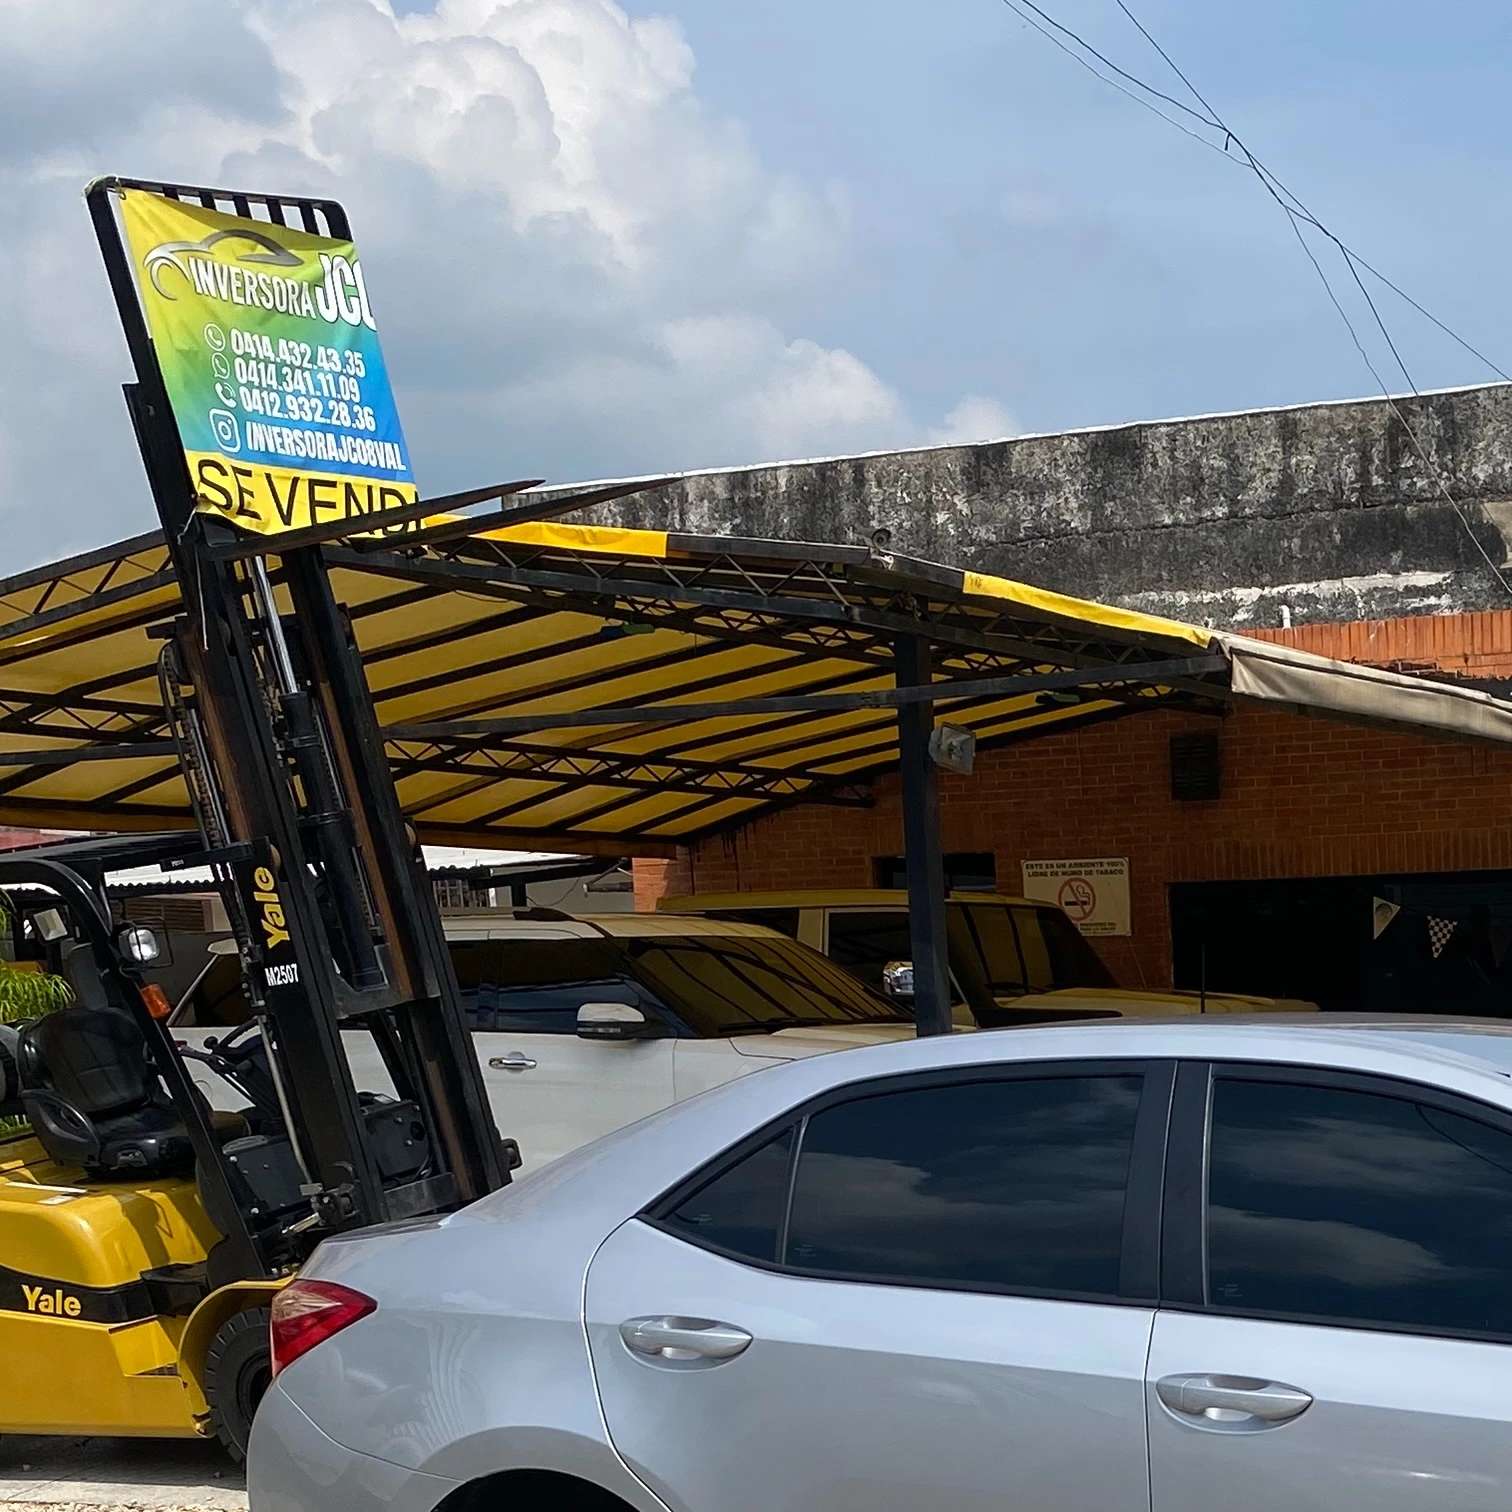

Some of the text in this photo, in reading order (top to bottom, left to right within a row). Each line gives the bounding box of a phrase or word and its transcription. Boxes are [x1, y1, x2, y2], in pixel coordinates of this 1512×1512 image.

[188, 257, 317, 320] INVERSORA
[230, 328, 367, 379] 0414.432.43.35
[234, 357, 362, 403] 0414.341.11.09
[238, 385, 376, 432] 0412.932.28.36
[198, 459, 263, 520] SE
[1068, 861, 1104, 869] AMBIENTE
[1096, 868, 1124, 876] TABACO
[253, 866, 291, 949] Yale
[264, 963, 299, 987] M2507
[21, 1284, 82, 1317] Yale
